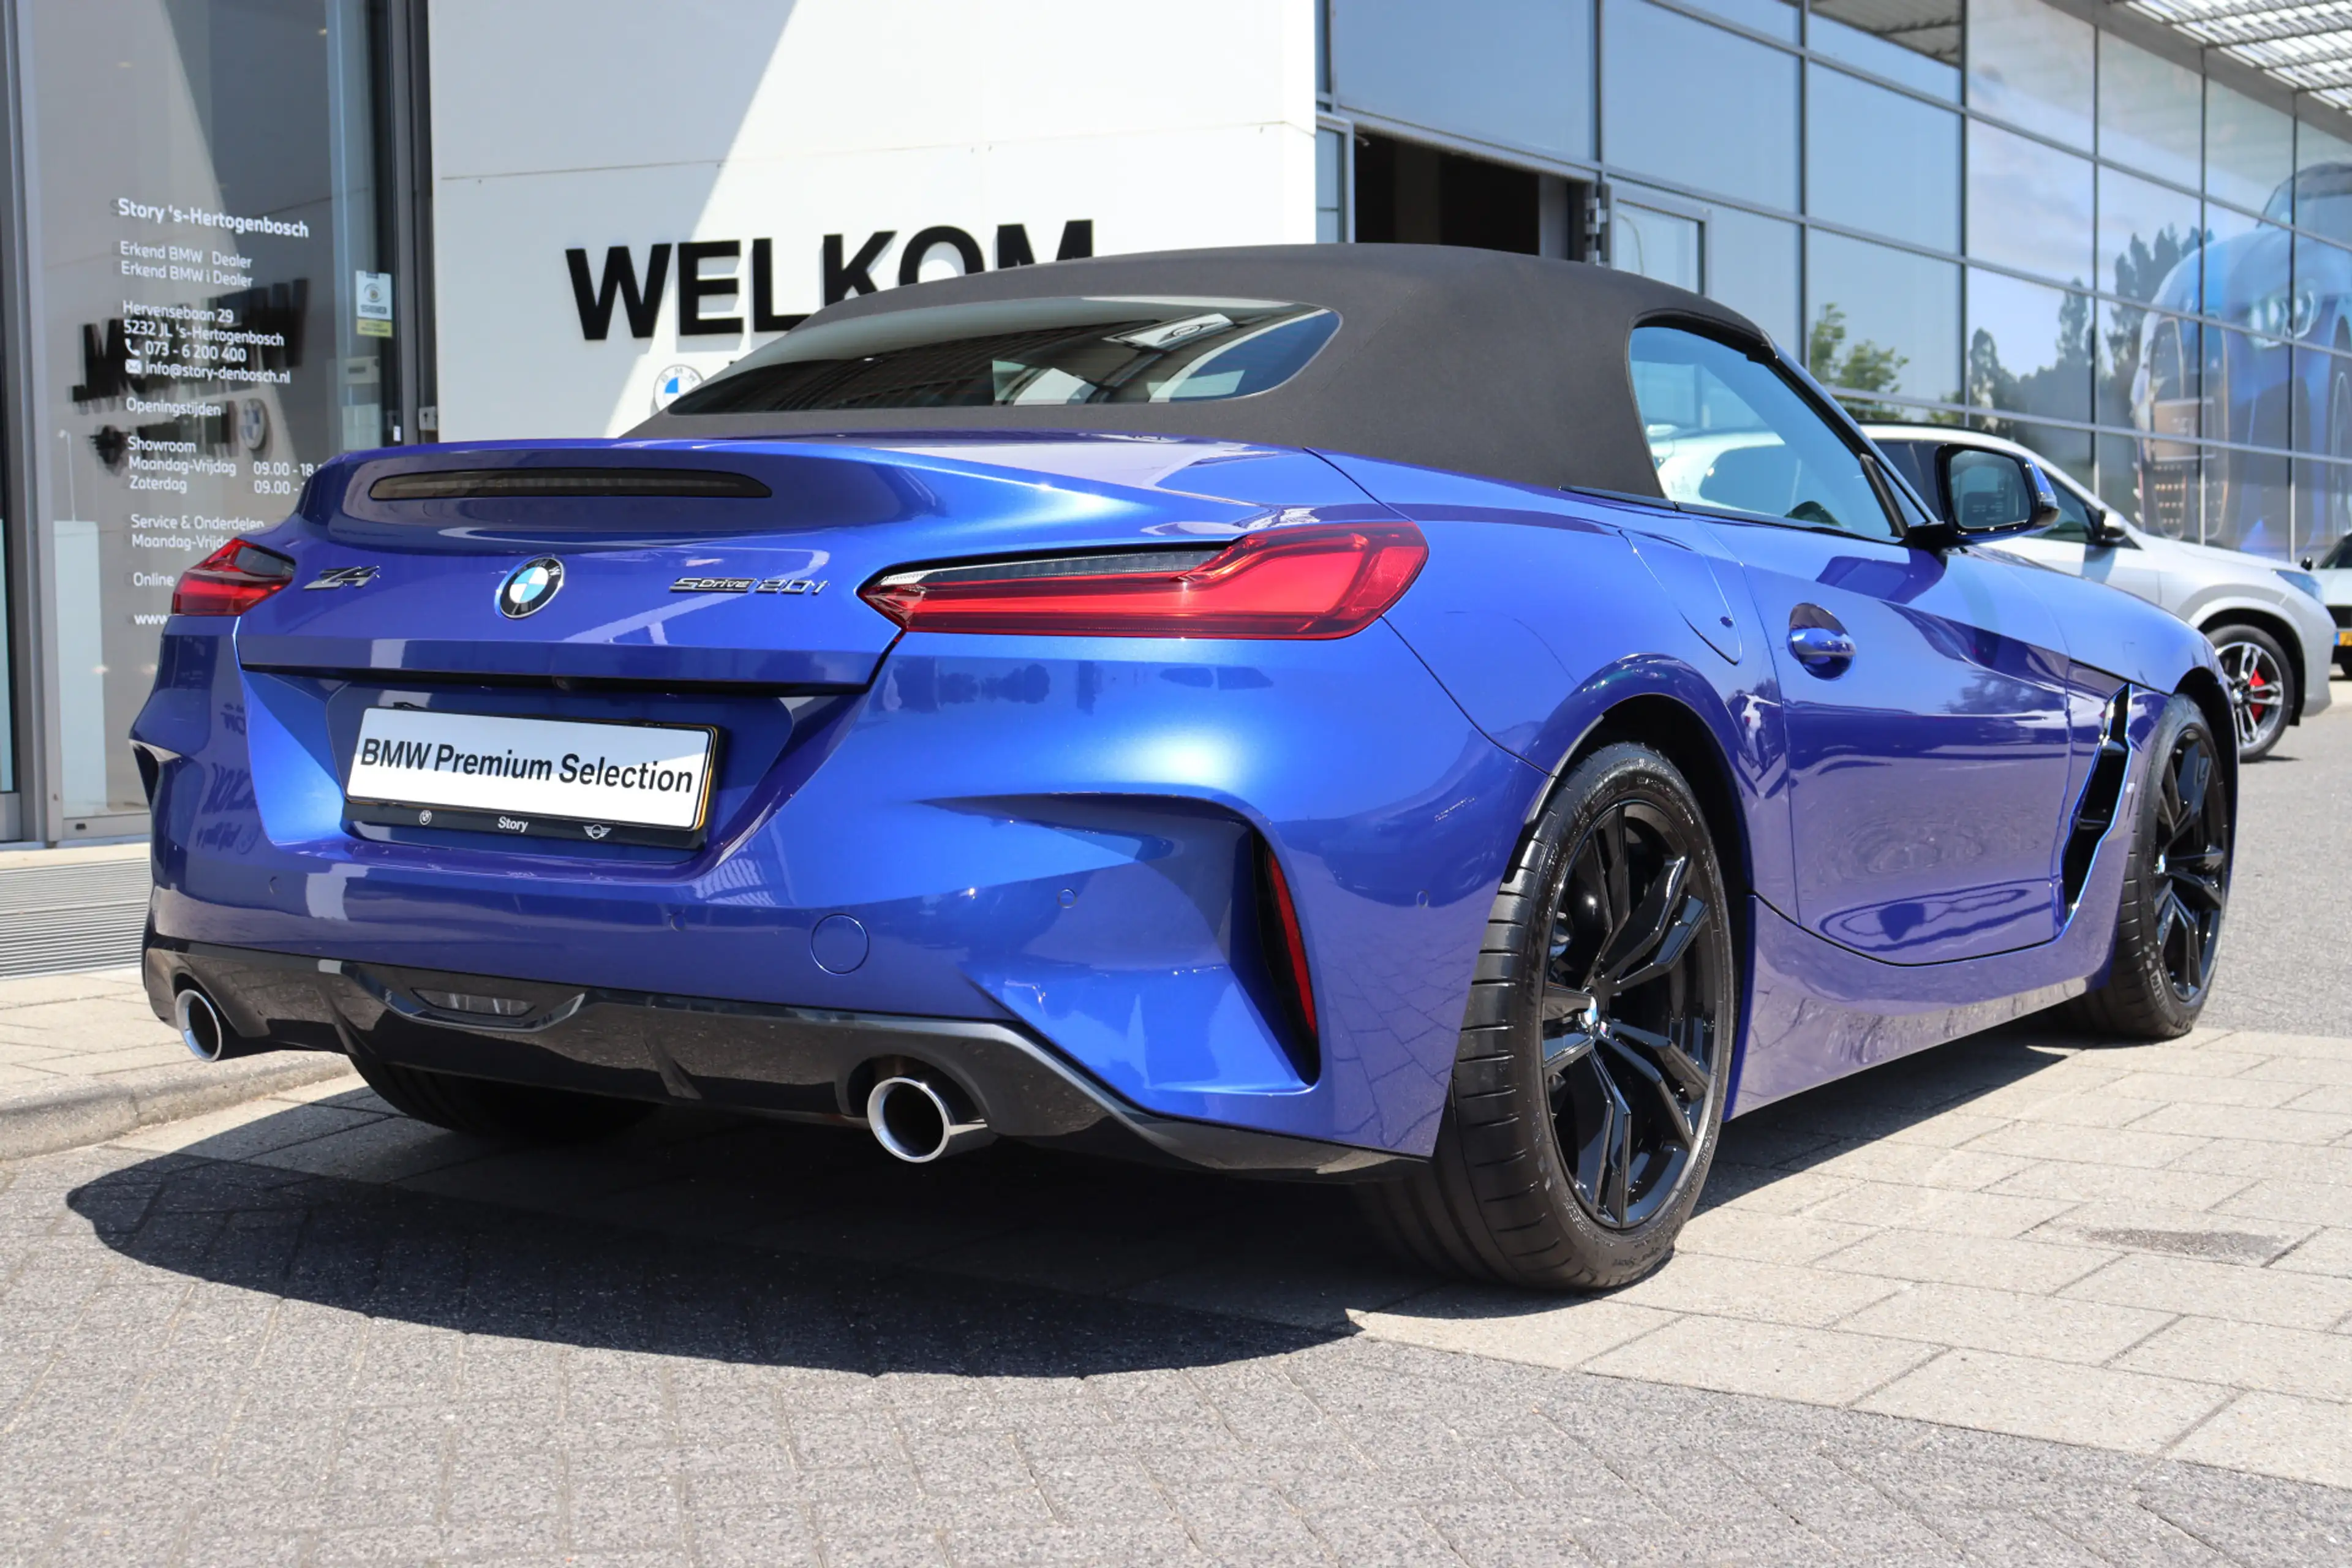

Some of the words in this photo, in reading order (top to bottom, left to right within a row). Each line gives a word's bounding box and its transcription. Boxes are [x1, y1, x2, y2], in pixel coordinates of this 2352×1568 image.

[118, 197, 164, 224] Story
[168, 205, 309, 238] 's-Hertogenbosch
[120, 241, 165, 259] Erkend
[169, 246, 203, 263] BMW
[212, 251, 252, 269] Dealer
[121, 260, 166, 278] Erkend
[170, 266, 203, 282] BMW
[206, 270, 210, 283] i
[213, 270, 253, 287] Dealer
[123, 300, 215, 322] Hervensebaan
[217, 309, 234, 323] 29
[124, 320, 156, 336] 5232
[159, 323, 173, 337] JL
[176, 326, 285, 346] 's-Hertogenbosch
[145, 341, 169, 356] 073
[181, 344, 190, 358] 6
[194, 344, 219, 360] 200
[221, 347, 247, 362] 400
[146, 361, 291, 383] info@story-denbosch.nl
[126, 397, 222, 417] Openingstijden
[127, 436, 196, 453] Showroom
[129, 456, 236, 476] Maandag-Vrijdag
[253, 461, 289, 477] 09.00
[129, 475, 187, 494] Zaterdag
[254, 480, 290, 494] 09.00
[130, 514, 178, 529] Service
[180, 515, 191, 529] &
[194, 516, 265, 531] Onderdelen
[133, 572, 175, 587] Online
[304, 565, 380, 589] Z4
[360, 737, 432, 771] BMW
[434, 744, 552, 782] Premium
[558, 753, 693, 794] Selection
[497, 816, 529, 833] Story
